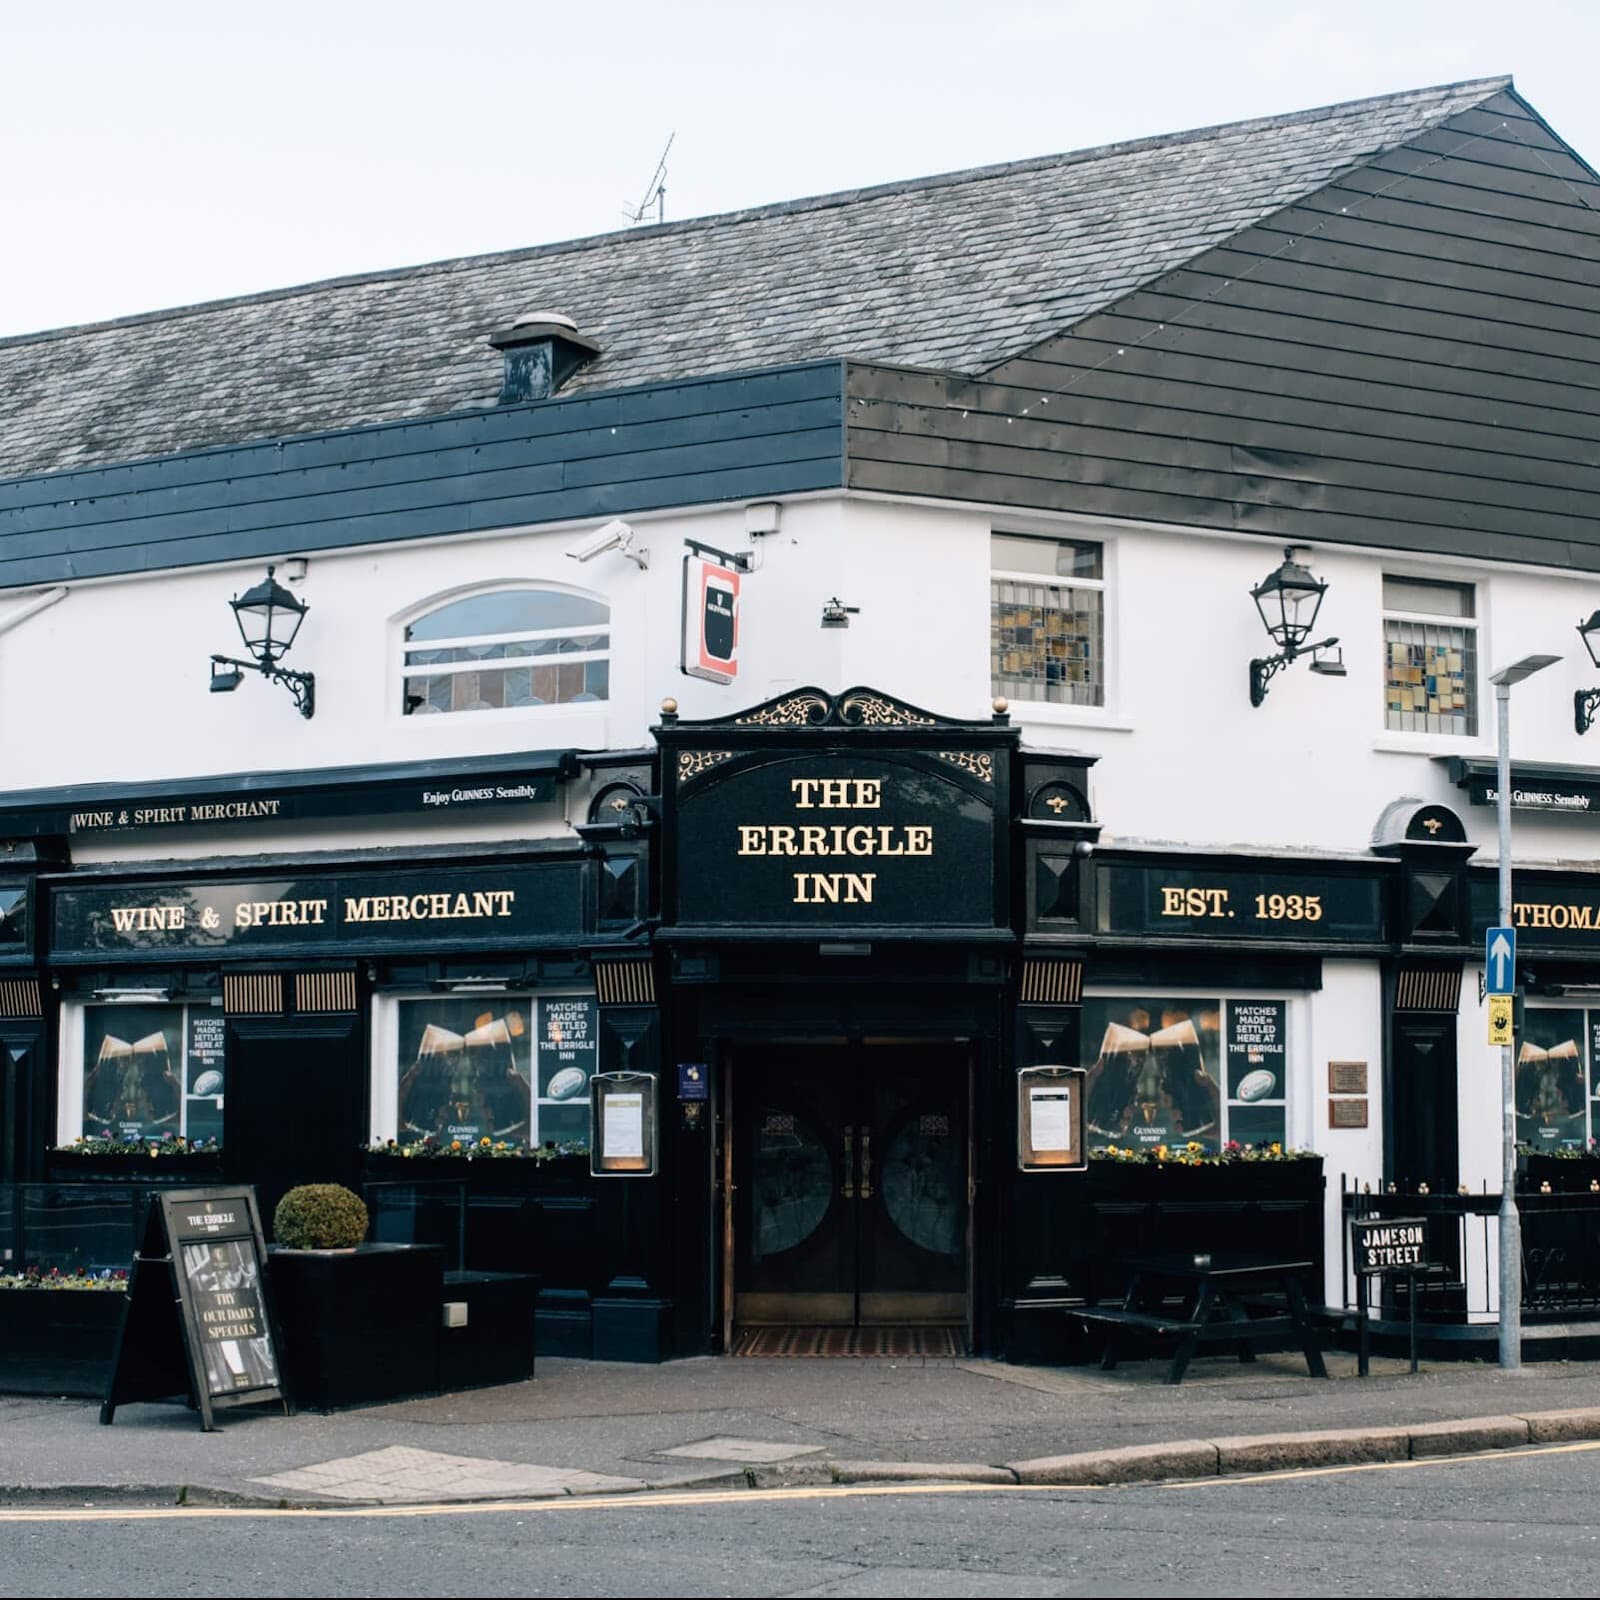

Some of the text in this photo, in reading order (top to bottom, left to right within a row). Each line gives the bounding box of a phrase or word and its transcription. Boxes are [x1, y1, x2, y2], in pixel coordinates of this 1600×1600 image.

[423, 784, 536, 806] Enjoy GUINNESS Sensibly
[791, 779, 881, 809] THE
[1513, 790, 1553, 803] GUINNESS
[1554, 793, 1590, 809] Sensibly
[73, 800, 281, 828] WINE & SPIRIT MERCHANT
[737, 826, 933, 855] ERRIGLE
[793, 873, 877, 903] INN
[1161, 887, 1322, 921] EST. 1935
[111, 891, 514, 932] WINE & SPIRIT MERCHANT
[546, 1003, 589, 1012] MATCHES
[1235, 1006, 1277, 1016] MATCHES
[551, 1012, 577, 1021] MADE
[1240, 1016, 1266, 1025] MADE
[547, 1021, 588, 1031] SETTLED
[1236, 1025, 1276, 1034] SETTLED
[548, 1030, 587, 1040] HERE AT
[1236, 1034, 1275, 1043] HERE AT
[540, 1041, 595, 1051] THE ERRIGLE
[1229, 1044, 1283, 1053] THE ERRIGLE
[560, 1051, 575, 1060] INN
[1248, 1054, 1264, 1063] INN
[1133, 1127, 1167, 1136] GUINNESS
[187, 1213, 235, 1226] THE ERRIGLE
[1362, 1227, 1423, 1247] JAMESON
[1368, 1246, 1420, 1265] STREET
[214, 1293, 236, 1305] TRY
[203, 1307, 256, 1322] OUR DAILY
[208, 1323, 257, 1339] SPECIALS
